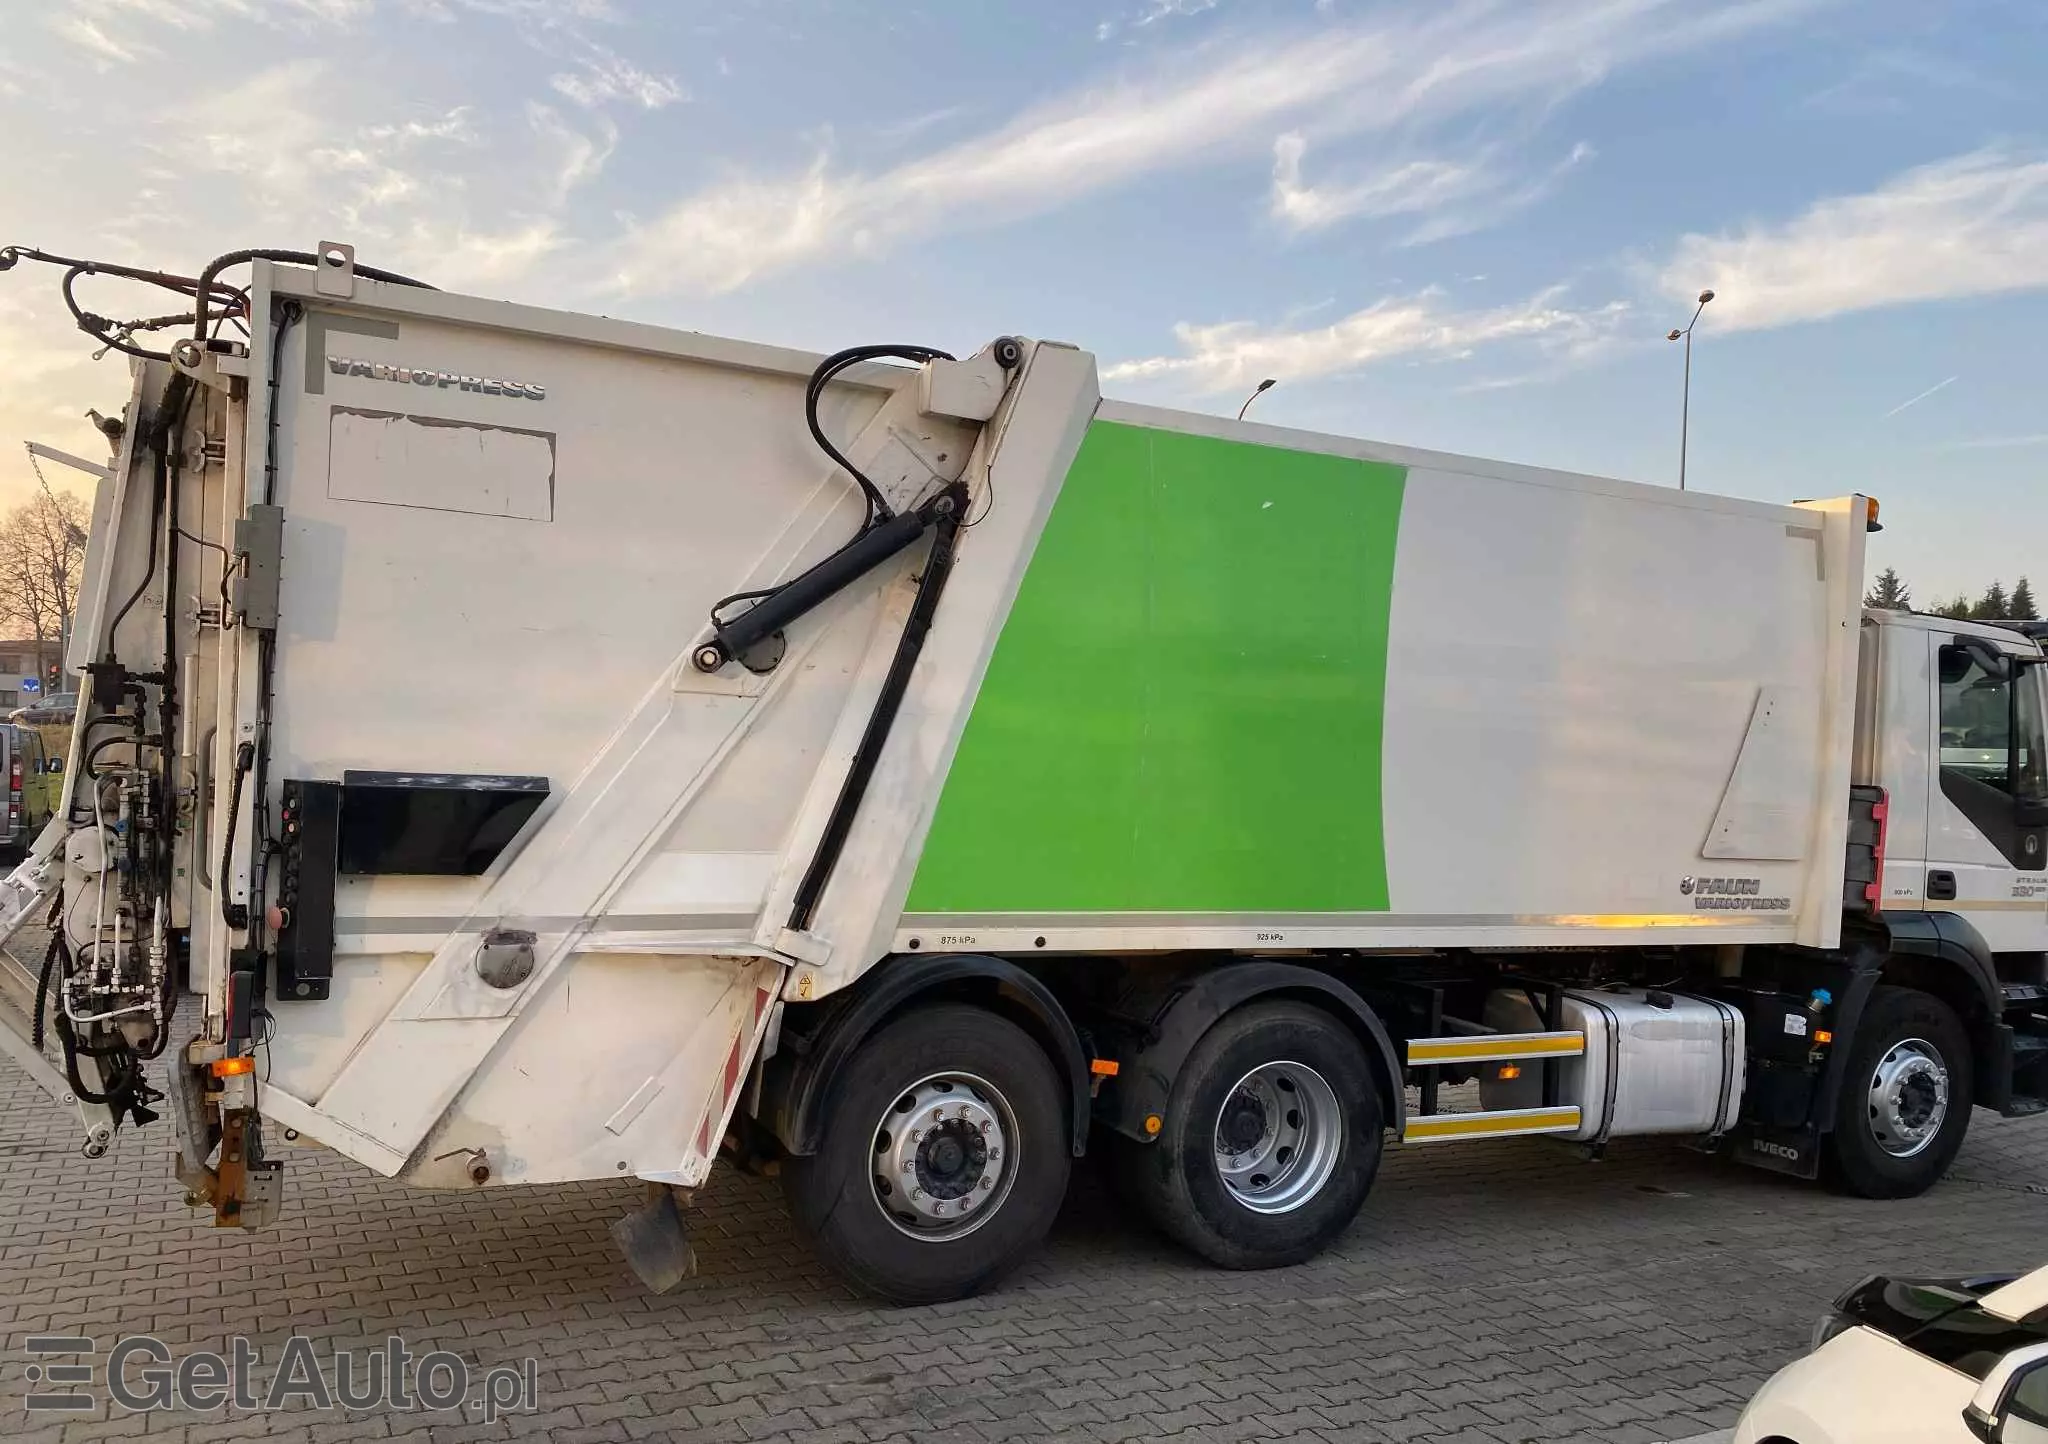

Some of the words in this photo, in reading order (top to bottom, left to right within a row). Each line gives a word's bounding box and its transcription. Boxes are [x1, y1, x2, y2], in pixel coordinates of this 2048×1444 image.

[327, 355, 545, 400] VARIOPRESS
[1696, 878, 1760, 895] FAUN
[940, 936, 957, 945] 875
[959, 936, 976, 944] kPa
[1270, 933, 1284, 941] kPa
[1753, 1139, 1799, 1160] IVECO
